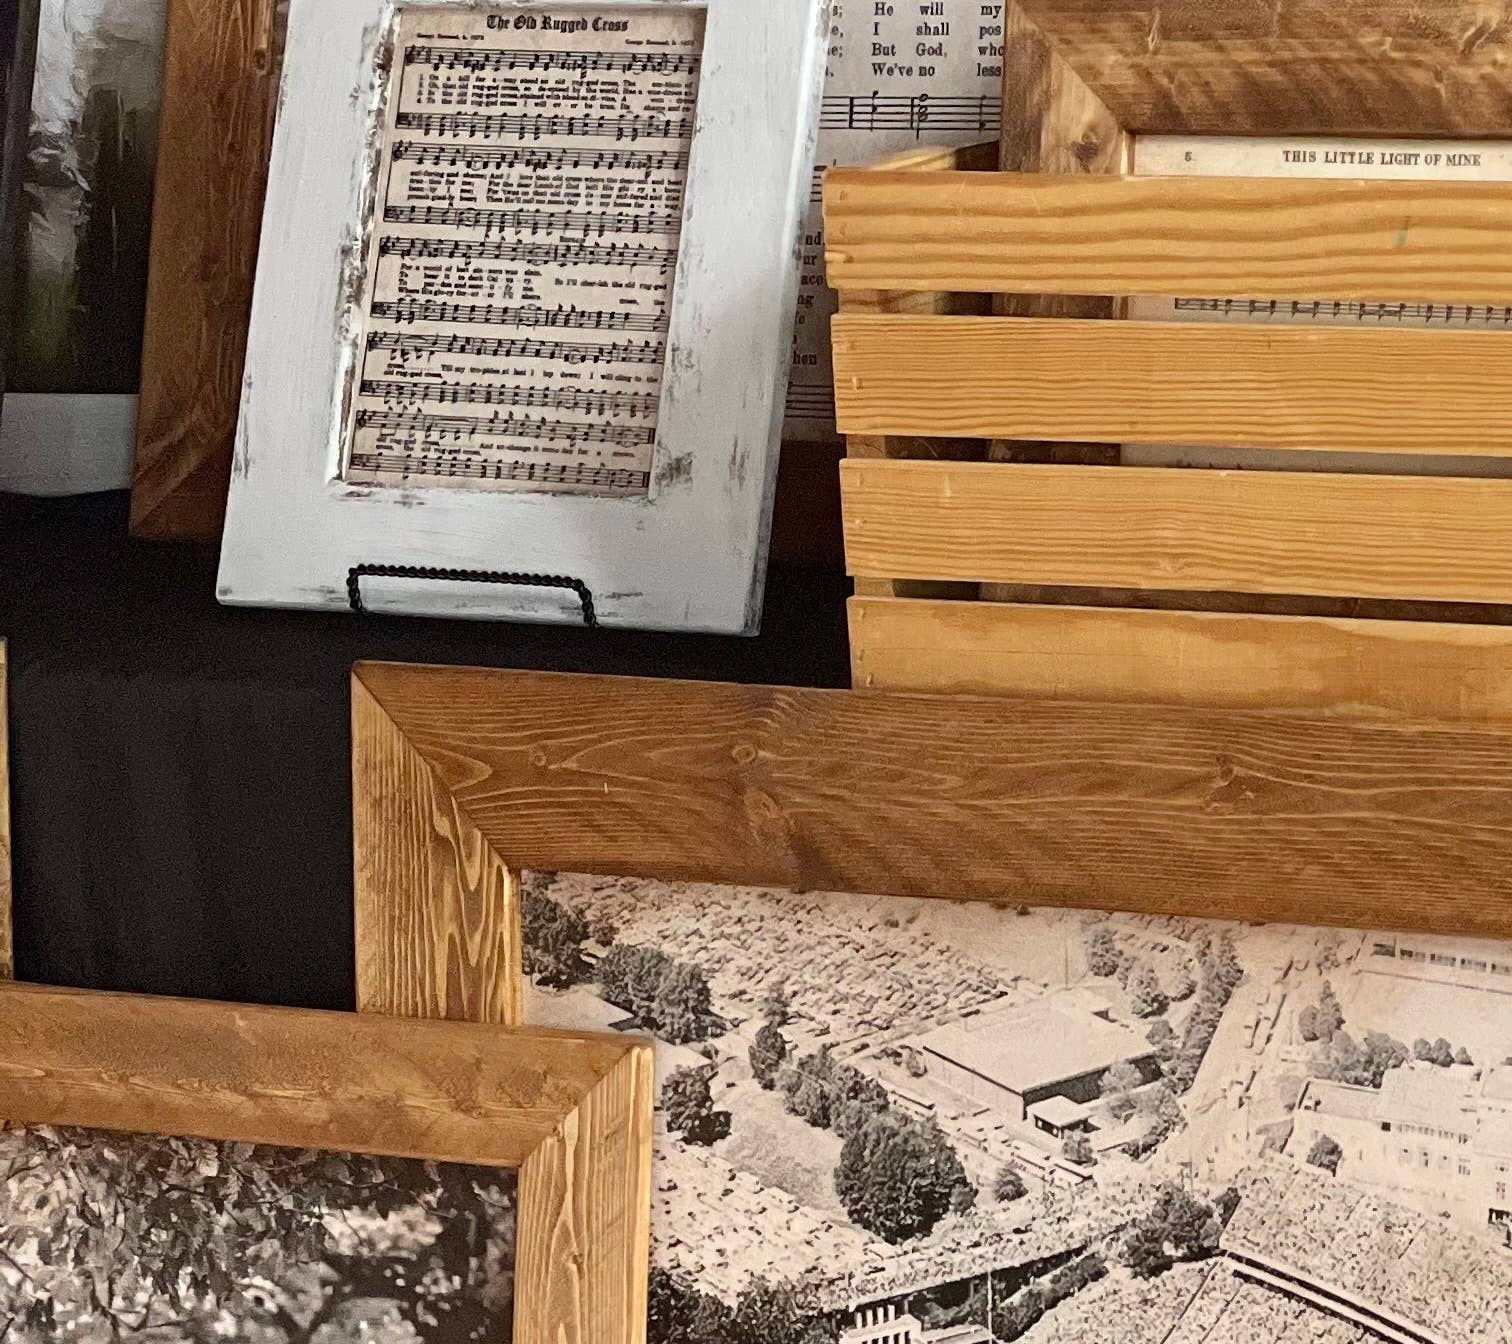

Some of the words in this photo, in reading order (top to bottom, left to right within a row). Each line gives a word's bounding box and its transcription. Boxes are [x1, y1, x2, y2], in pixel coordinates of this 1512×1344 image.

[873, 1, 894, 17] He
[919, 1, 944, 16] will
[981, 5, 1002, 18] my
[487, 15, 510, 30] The
[513, 15, 537, 29] Old
[541, 17, 588, 33] Rugged
[591, 18, 629, 31] Cross
[873, 21, 880, 36] I
[915, 21, 950, 36] shall
[871, 42, 897, 57] But
[871, 62, 914, 77] We've
[918, 65, 936, 77] no
[1283, 150, 1317, 163] THIS
[1324, 151, 1375, 165] LITTLE
[1380, 152, 1420, 166] LIGHT
[1424, 153, 1441, 166] OF
[1446, 154, 1481, 167] MINE
